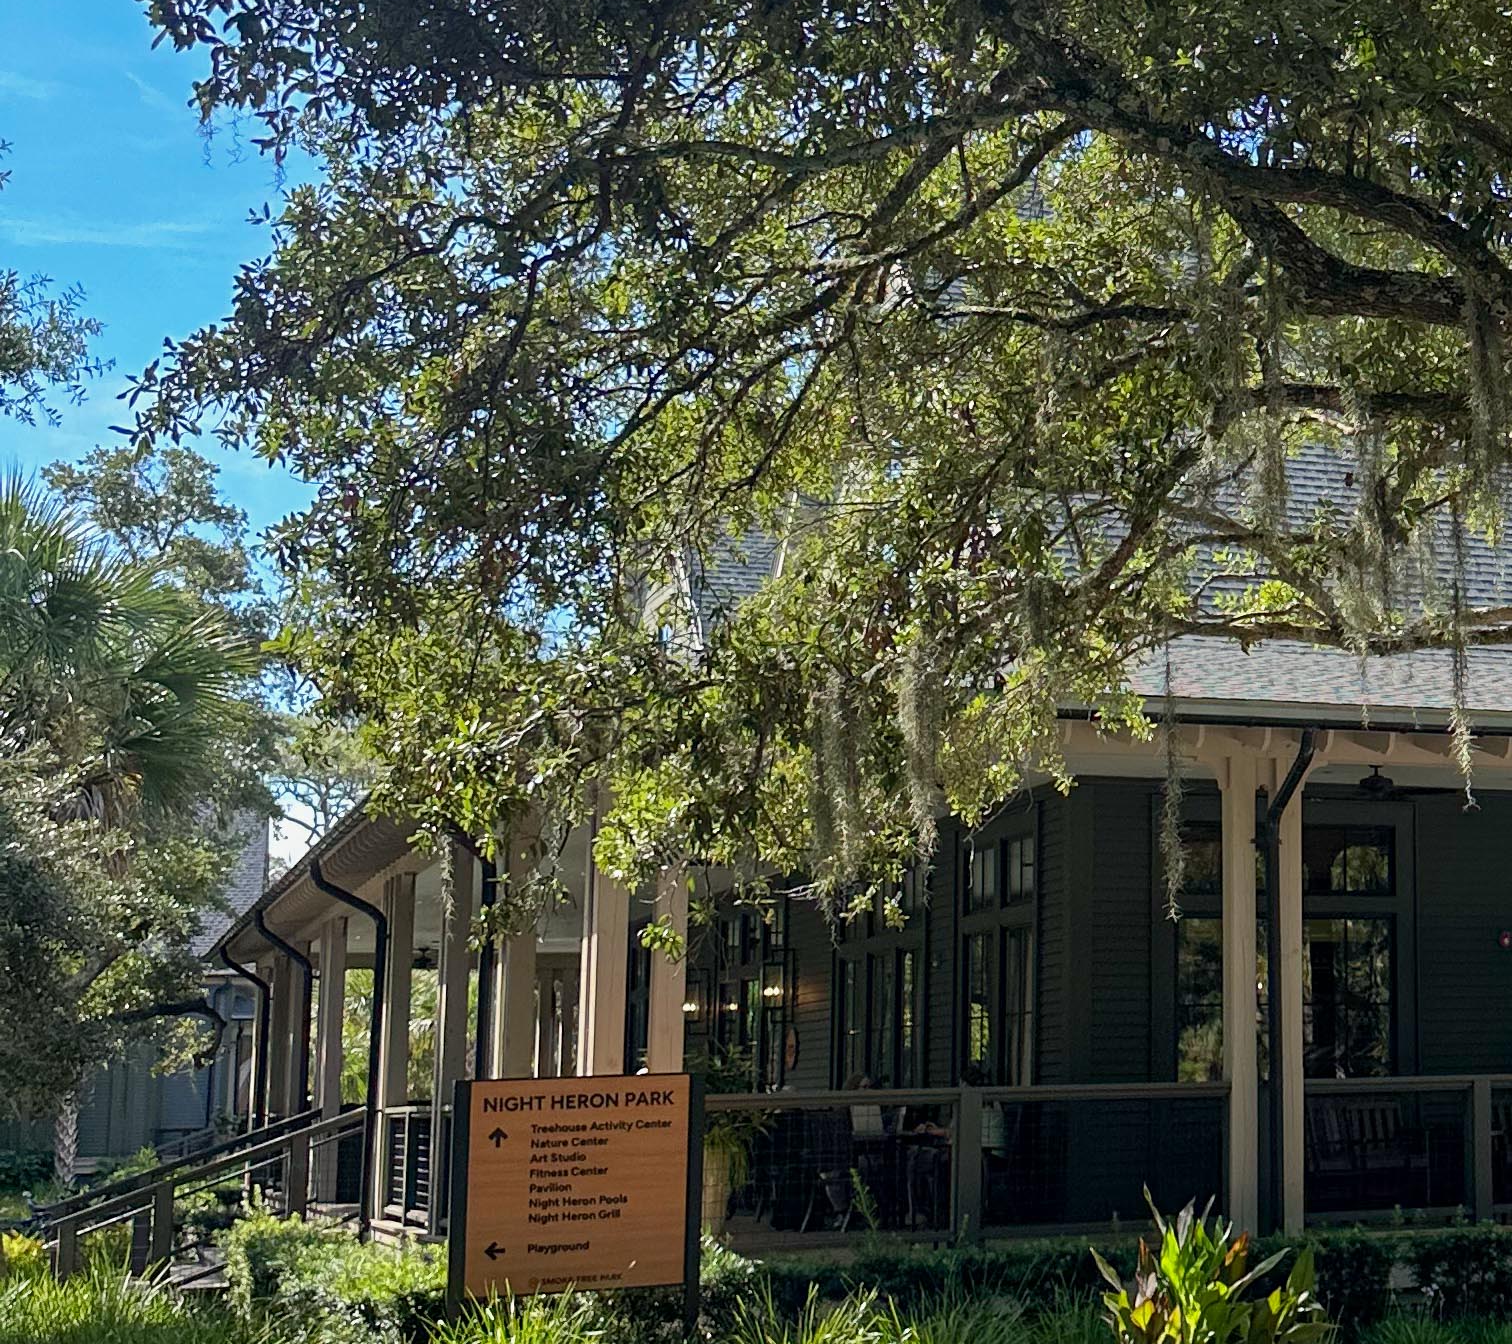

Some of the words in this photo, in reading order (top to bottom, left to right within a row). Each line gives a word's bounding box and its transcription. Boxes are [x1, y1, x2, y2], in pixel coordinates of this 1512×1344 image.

[483, 1096, 546, 1113] NIGHT
[551, 1093, 619, 1110] HERON
[625, 1090, 675, 1106] PARK
[531, 1123, 587, 1134] Treehouse
[590, 1120, 633, 1132] Activity
[635, 1119, 672, 1129] Center
[531, 1139, 568, 1149] Nature
[571, 1137, 609, 1147] Center
[530, 1154, 547, 1164] Art
[551, 1152, 587, 1163] Studio
[529, 1169, 568, 1179] Fitness
[571, 1167, 609, 1176] Center
[529, 1182, 572, 1194] Pavilion
[528, 1198, 560, 1210] Night
[562, 1197, 596, 1207] Heron
[599, 1193, 628, 1204] Pools
[528, 1212, 559, 1225] Night
[562, 1211, 596, 1221] Heron
[598, 1208, 621, 1219] Grill
[527, 1240, 590, 1255] Playground
